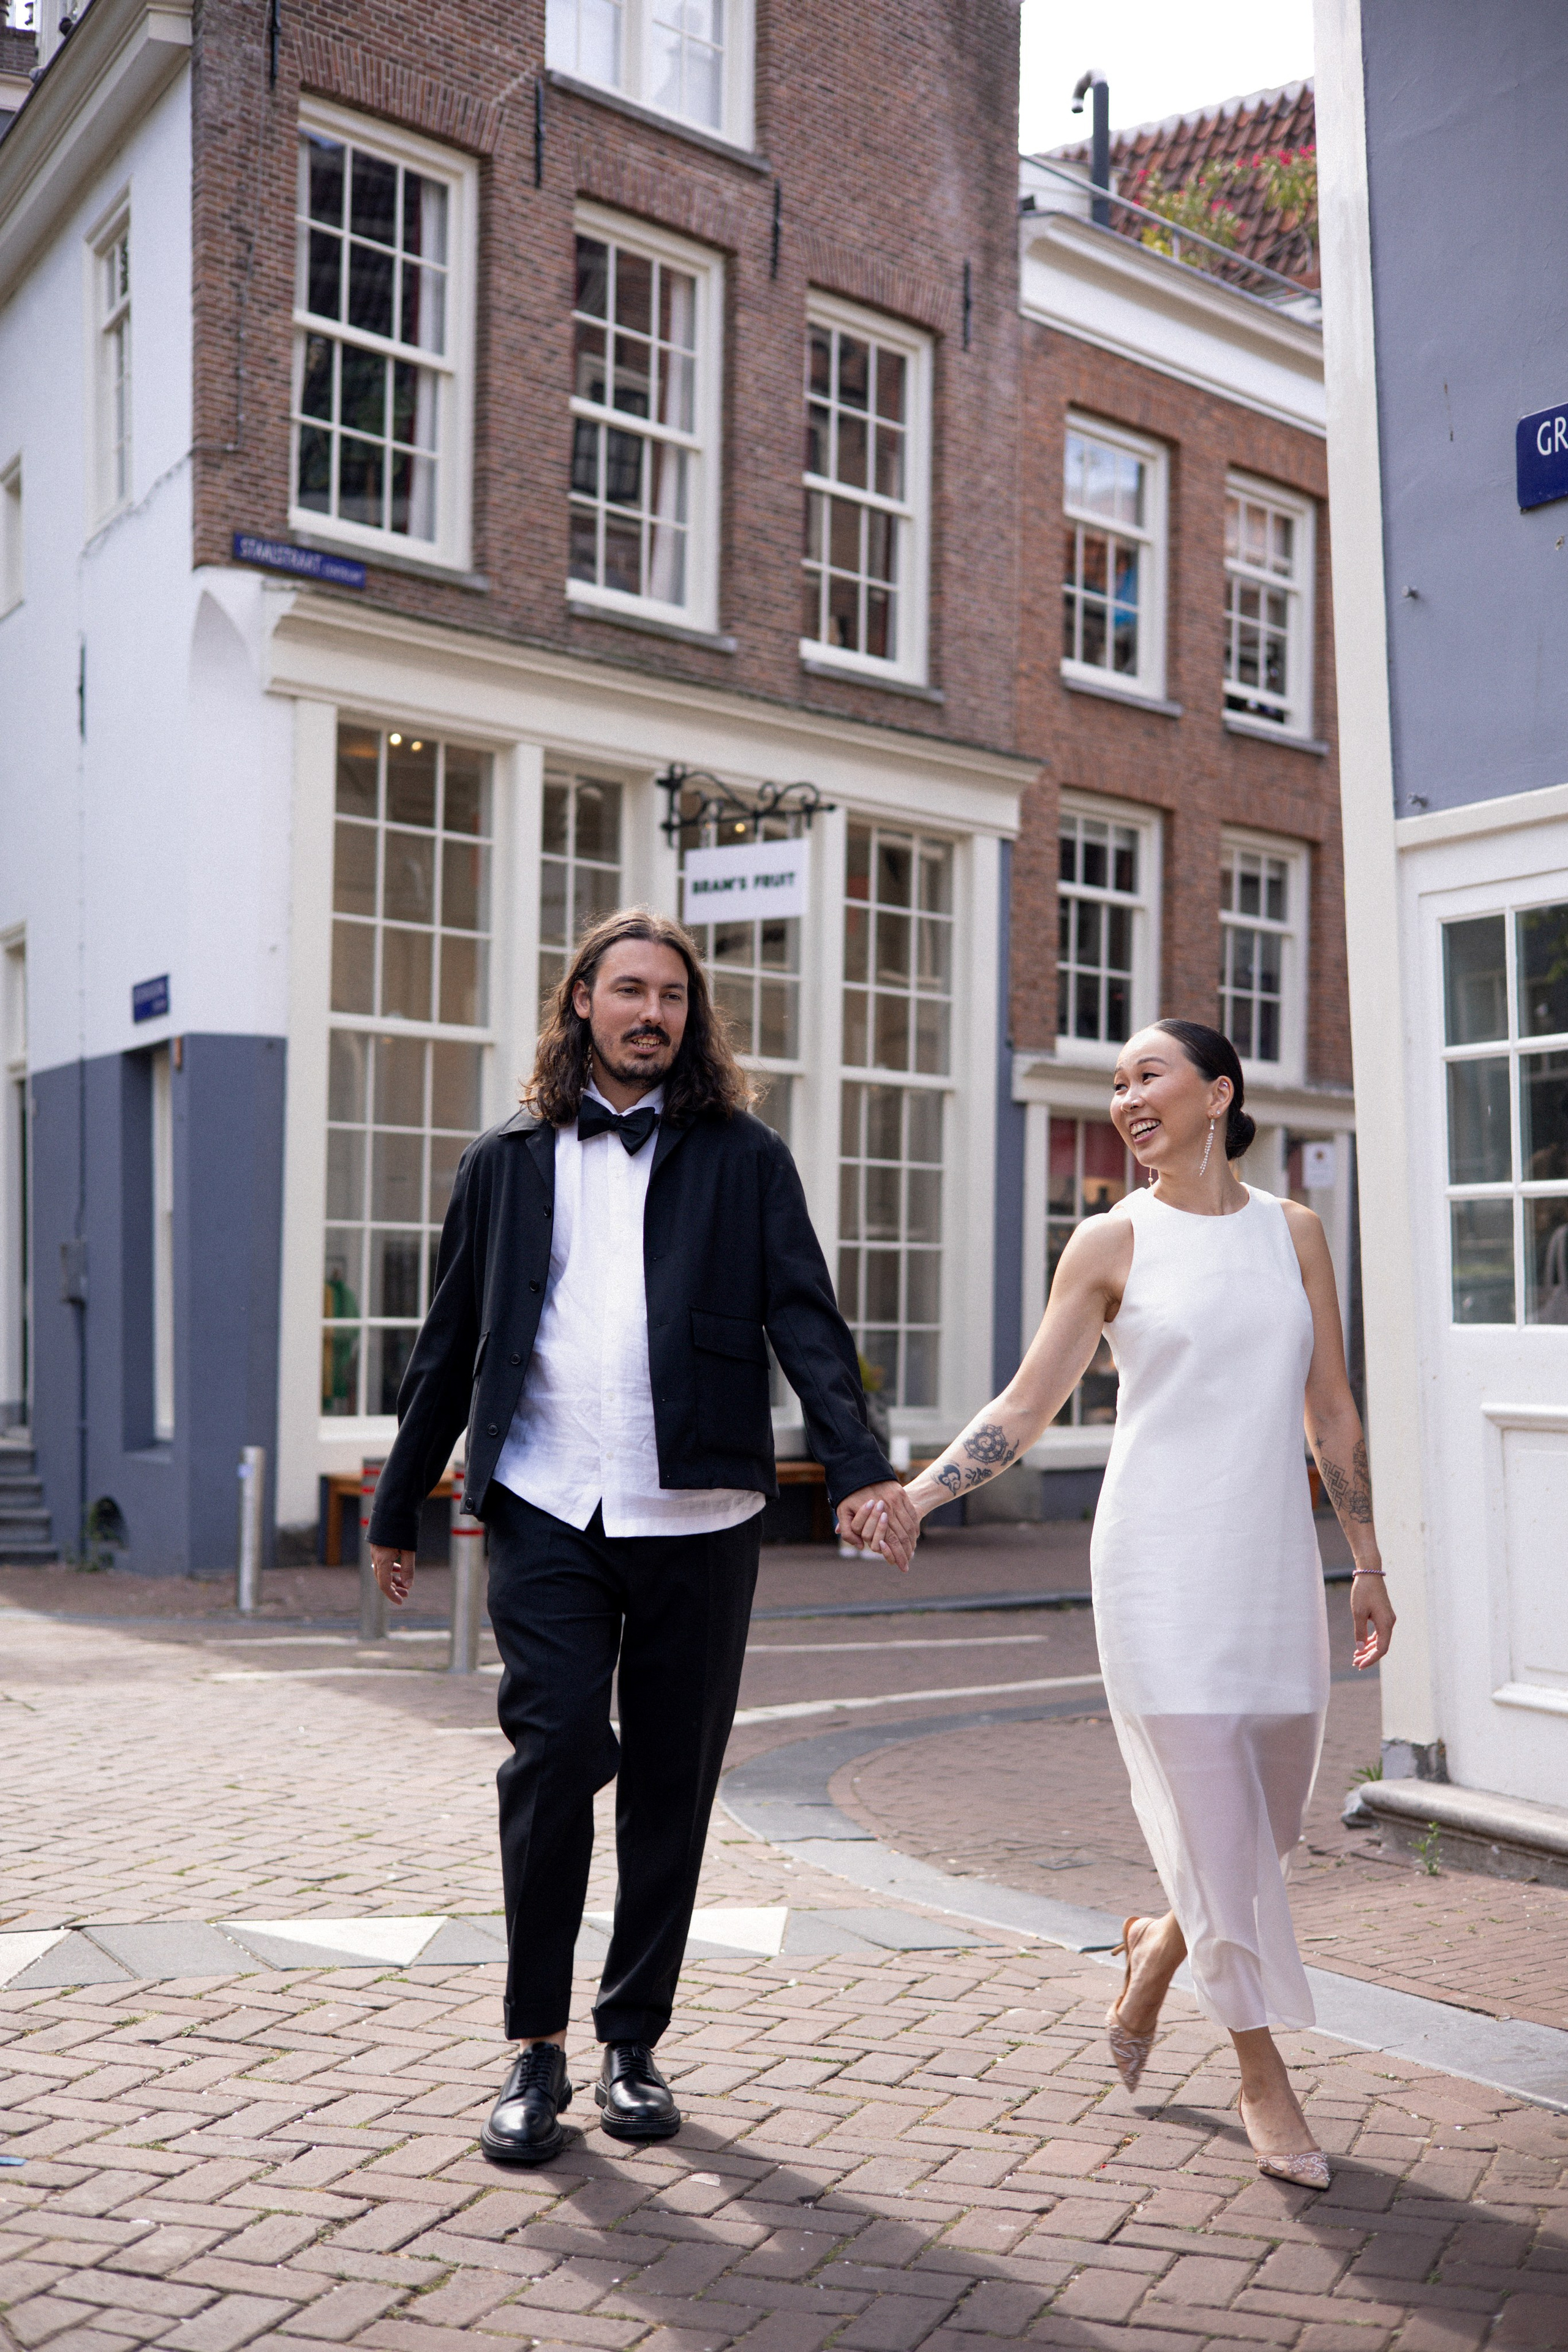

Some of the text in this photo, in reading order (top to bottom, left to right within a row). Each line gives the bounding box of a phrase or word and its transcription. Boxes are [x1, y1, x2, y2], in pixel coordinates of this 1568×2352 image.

[1537, 417, 1568, 456] GR
[693, 871, 796, 894] BRAM'S FRUIT
